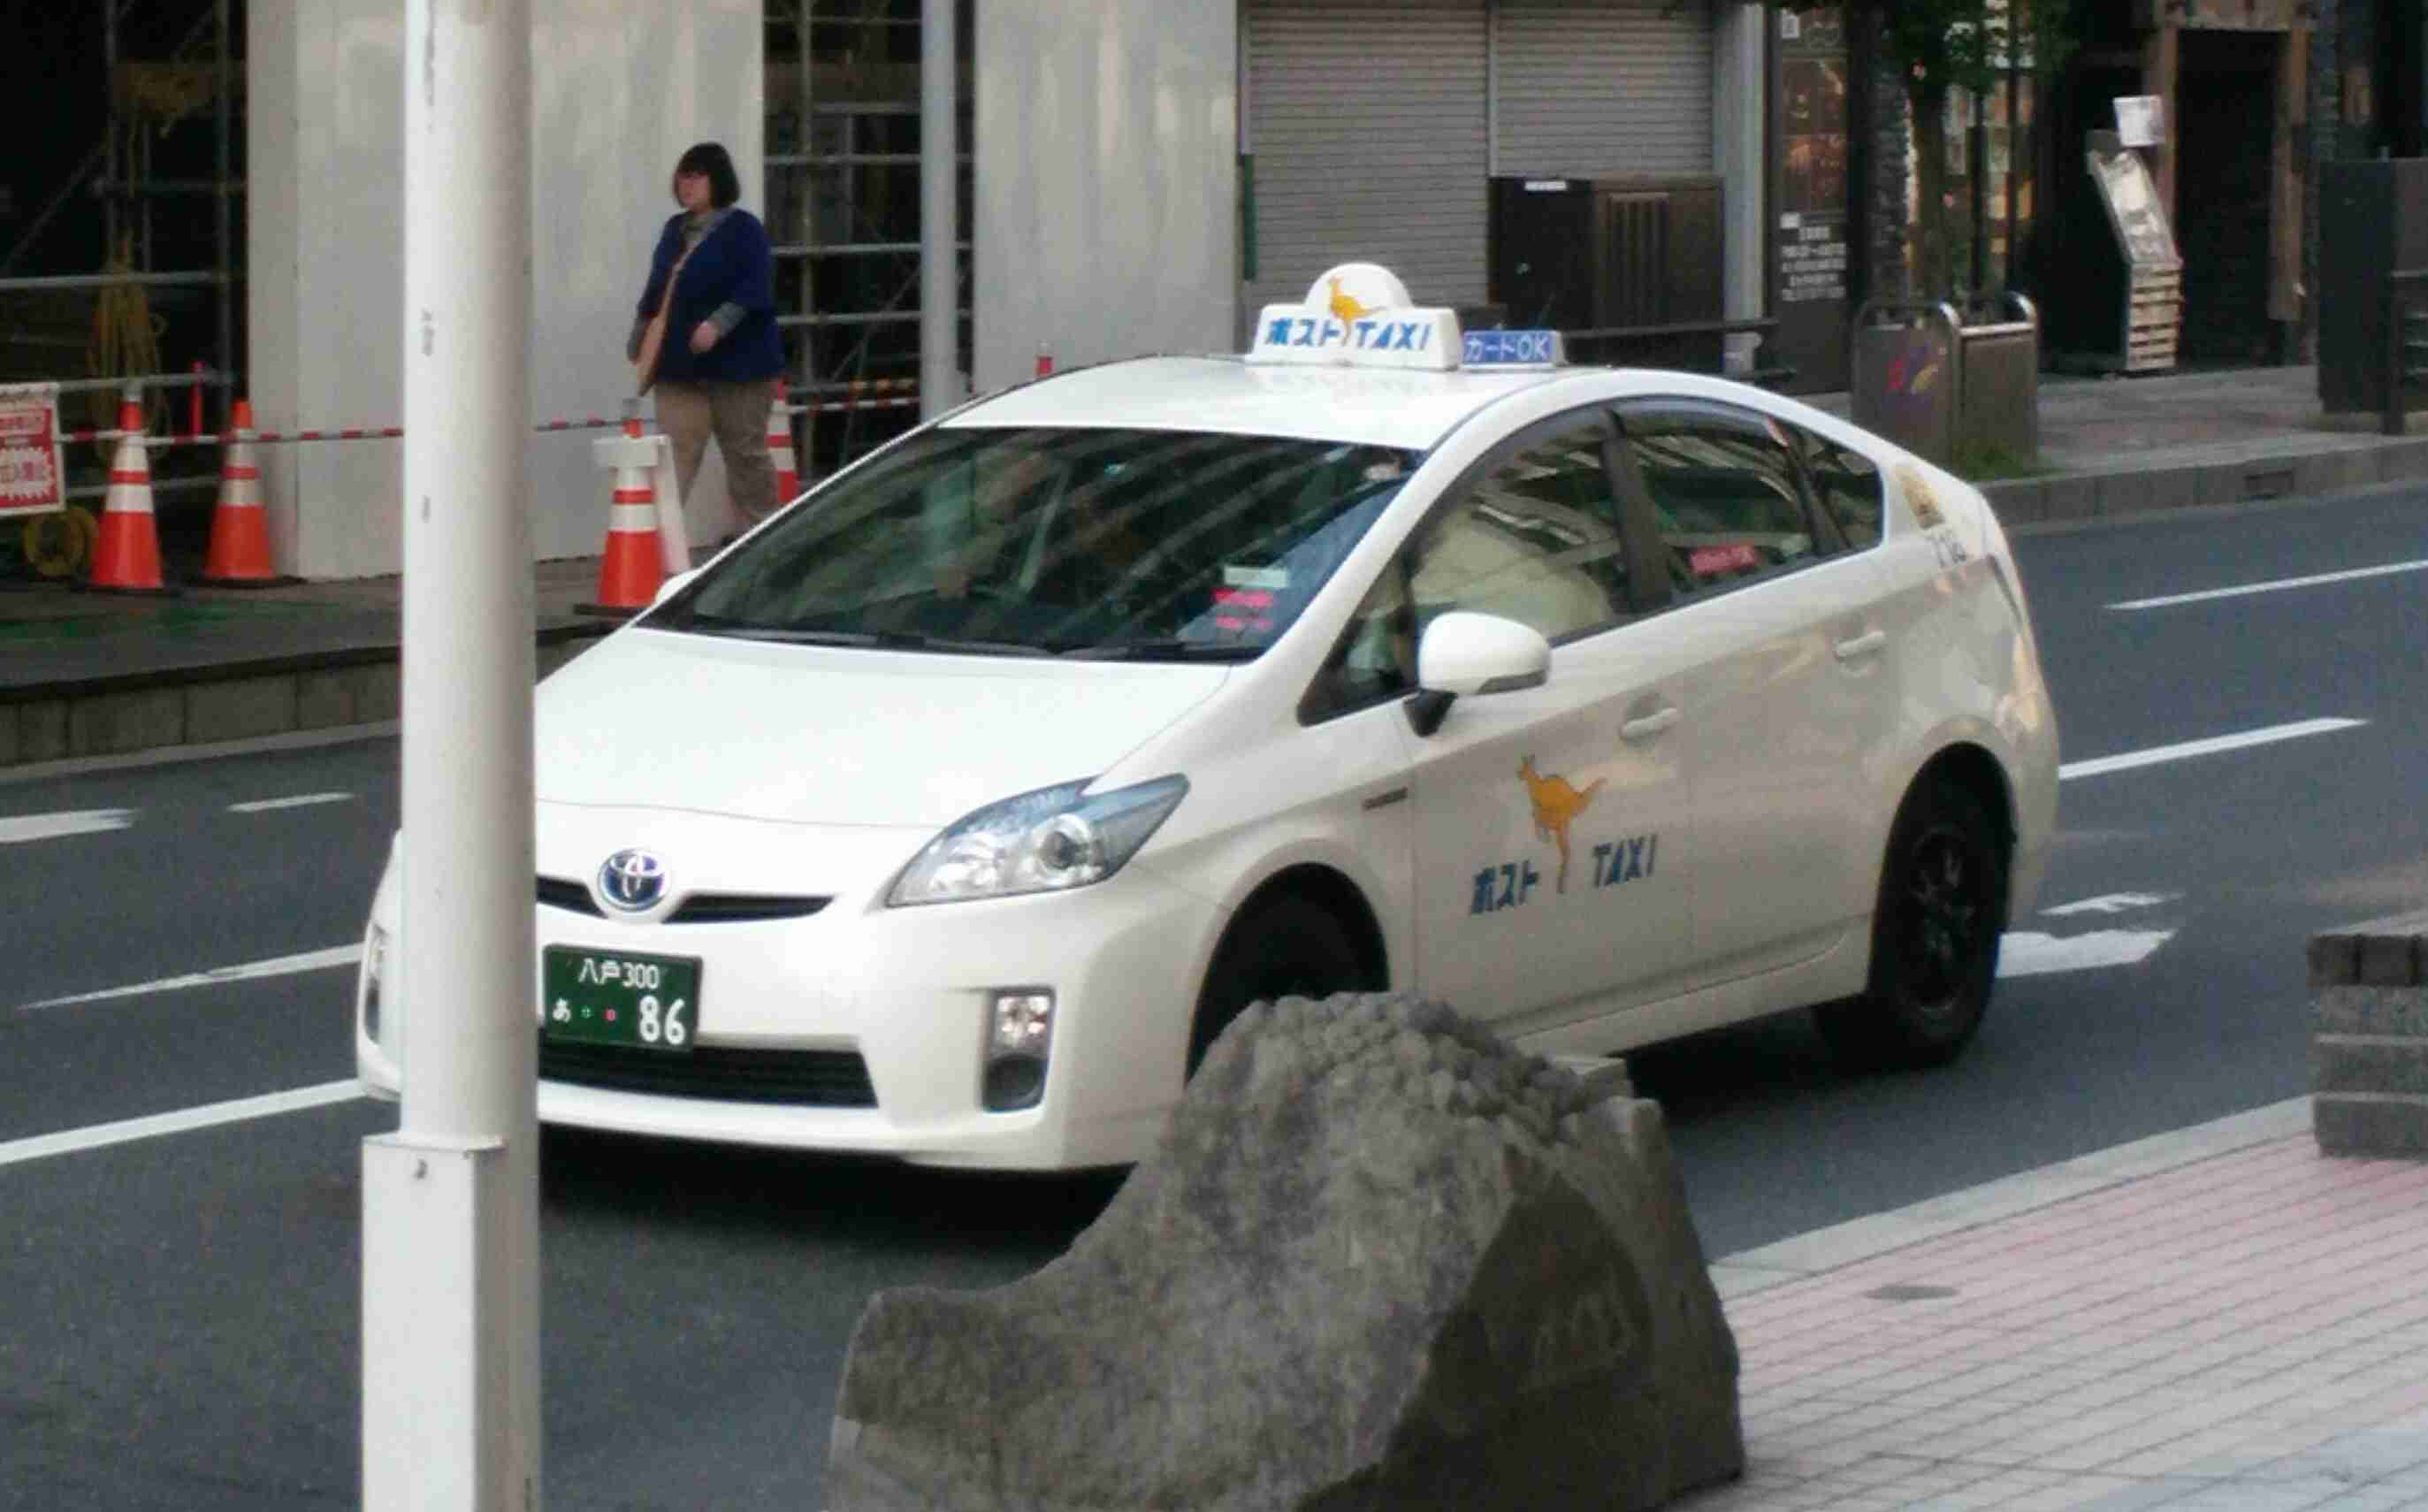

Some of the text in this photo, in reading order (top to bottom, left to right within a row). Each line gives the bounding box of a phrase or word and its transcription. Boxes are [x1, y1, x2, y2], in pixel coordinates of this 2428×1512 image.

[1355, 320, 1434, 351] TAXI
[1464, 332, 1551, 362] カードOK
[1592, 833, 1658, 889] TAXI
[638, 994, 687, 1046] 86
